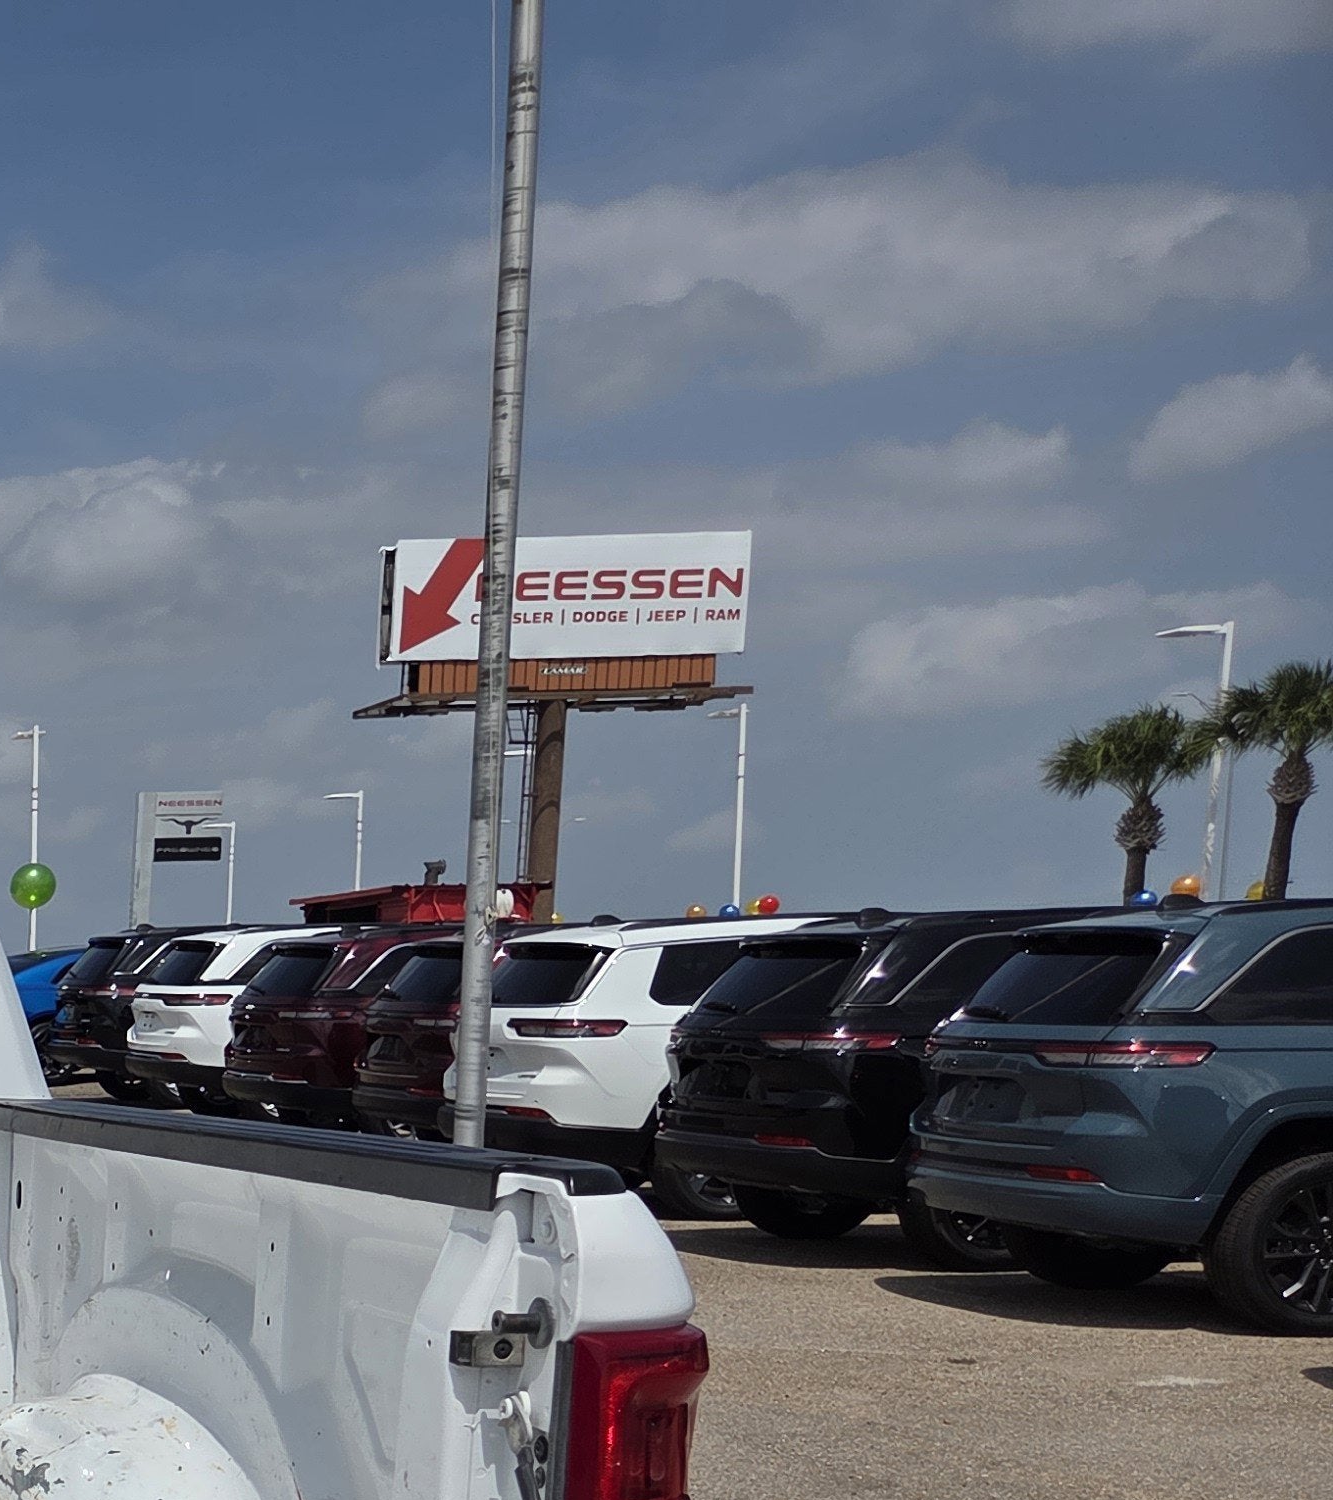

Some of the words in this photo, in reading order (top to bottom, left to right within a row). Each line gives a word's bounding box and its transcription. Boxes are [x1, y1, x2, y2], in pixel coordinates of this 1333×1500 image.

[470, 612, 553, 626] CSLER
[572, 610, 629, 624] DODGE
[646, 609, 686, 623] JEEP
[705, 608, 741, 622] RAM
[158, 799, 223, 808] NEESSEN
